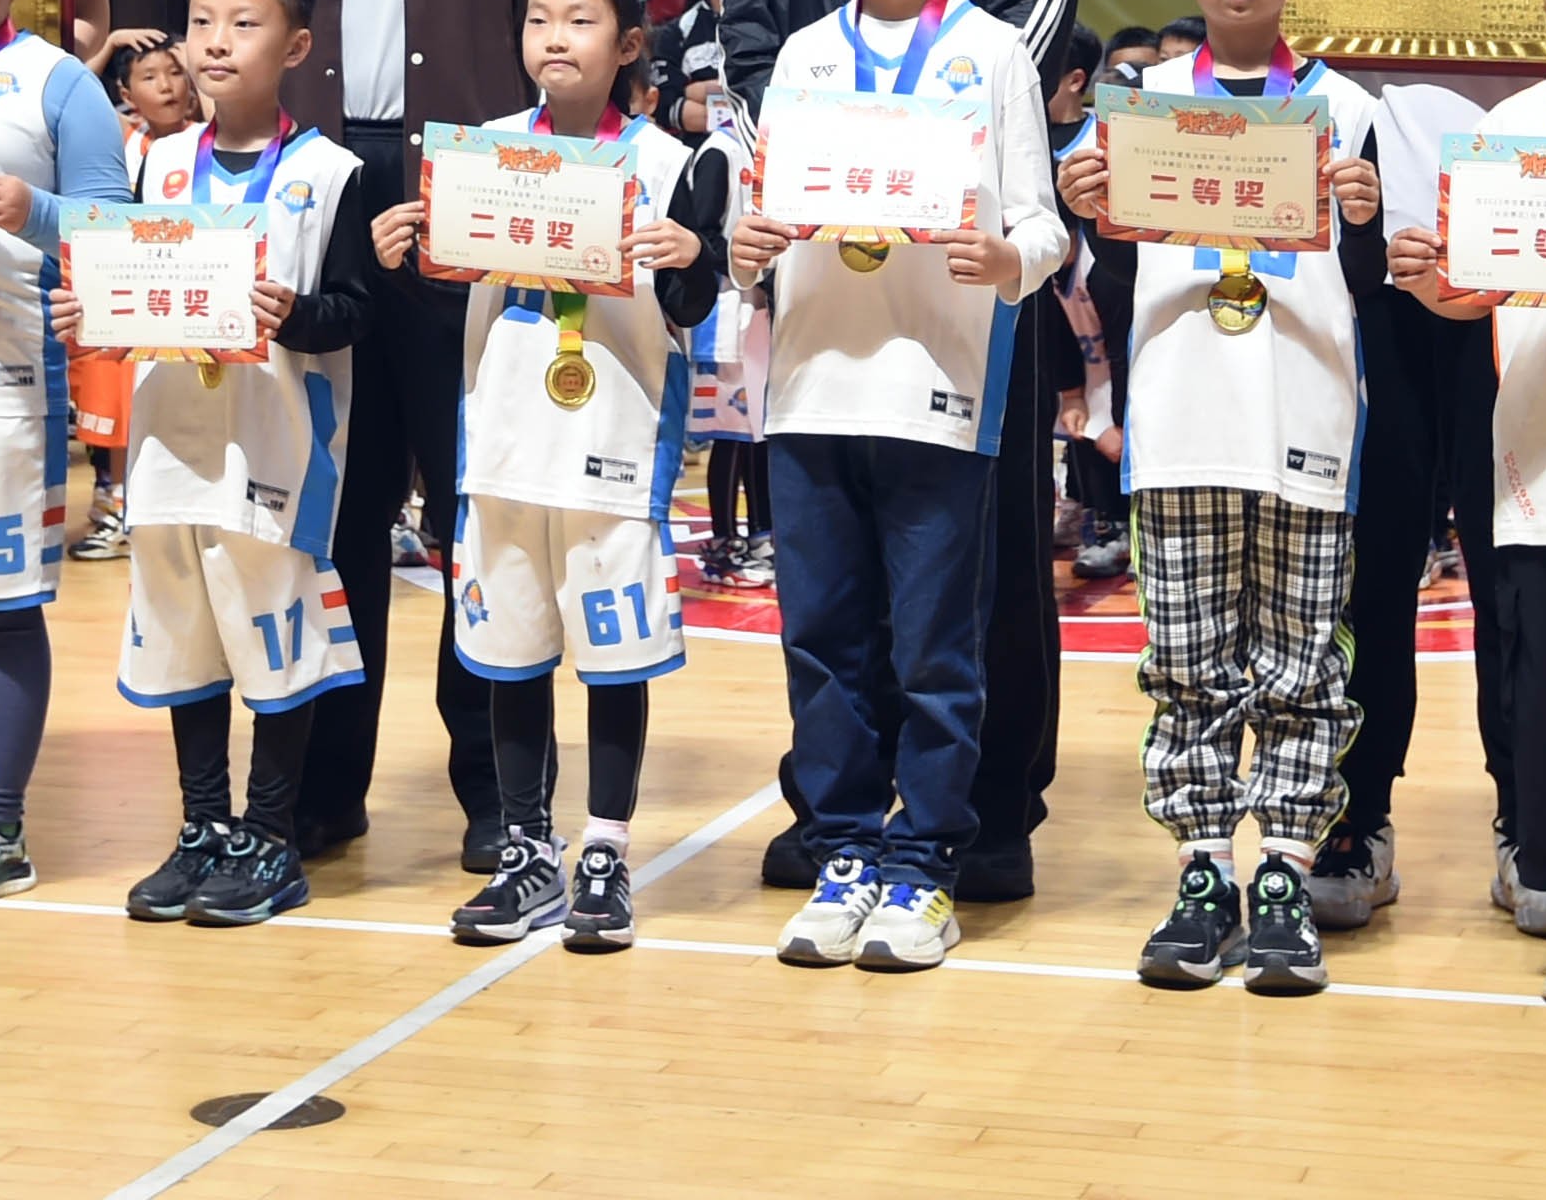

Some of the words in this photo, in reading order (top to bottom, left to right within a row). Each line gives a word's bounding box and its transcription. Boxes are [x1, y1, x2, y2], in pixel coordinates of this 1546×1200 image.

[804, 166, 915, 197] 二等奖
[1149, 174, 1265, 208] 二等奖
[469, 212, 575, 251] 二等奖
[111, 288, 210, 317] 二等奖
[581, 582, 652, 648] 61
